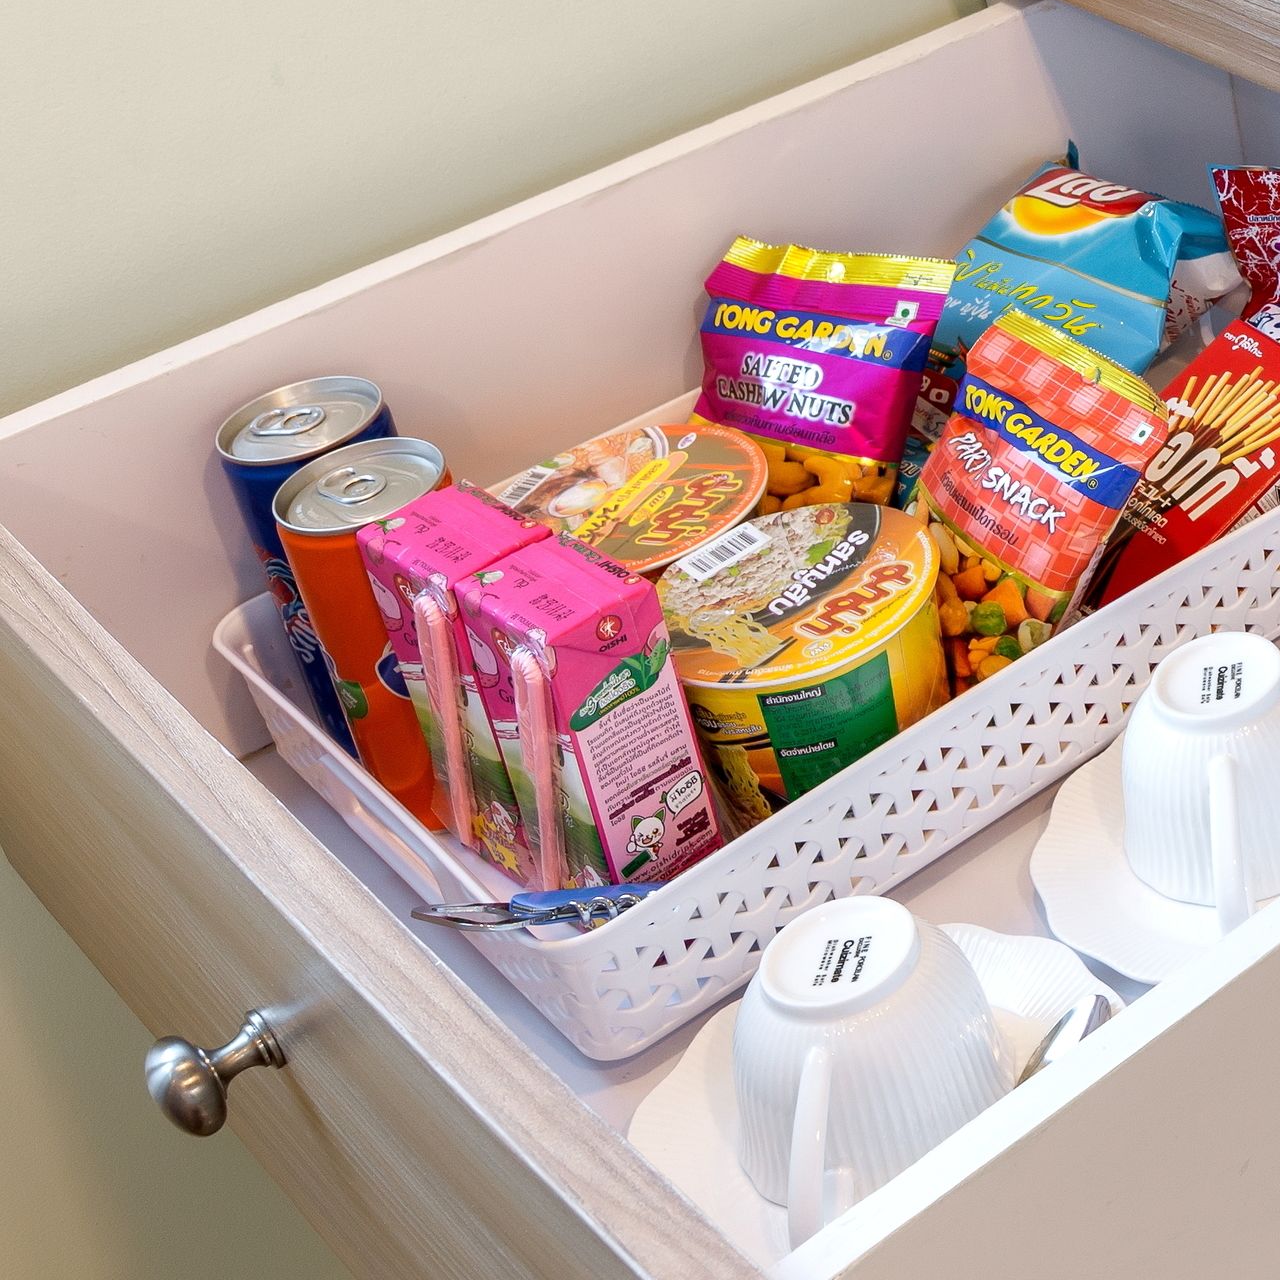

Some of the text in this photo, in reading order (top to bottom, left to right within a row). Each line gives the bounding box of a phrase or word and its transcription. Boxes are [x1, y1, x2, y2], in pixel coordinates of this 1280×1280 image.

[714, 304, 776, 332] TONG
[718, 378, 853, 425] CASHEW NUTS
[965, 384, 1015, 424] TONG
[1005, 412, 1101, 483] GARDEN
[981, 466, 1066, 534] SNACK
[768, 529, 870, 616] รสหมูสับ
[800, 564, 913, 635] มาม่า
[599, 634, 628, 653] OISHI
[766, 686, 822, 705] สำนักงานใหญ่
[780, 741, 836, 758] จัดจำหน่ายโดย
[831, 940, 854, 983] Cuizimate
[861, 936, 872, 953] FINE
